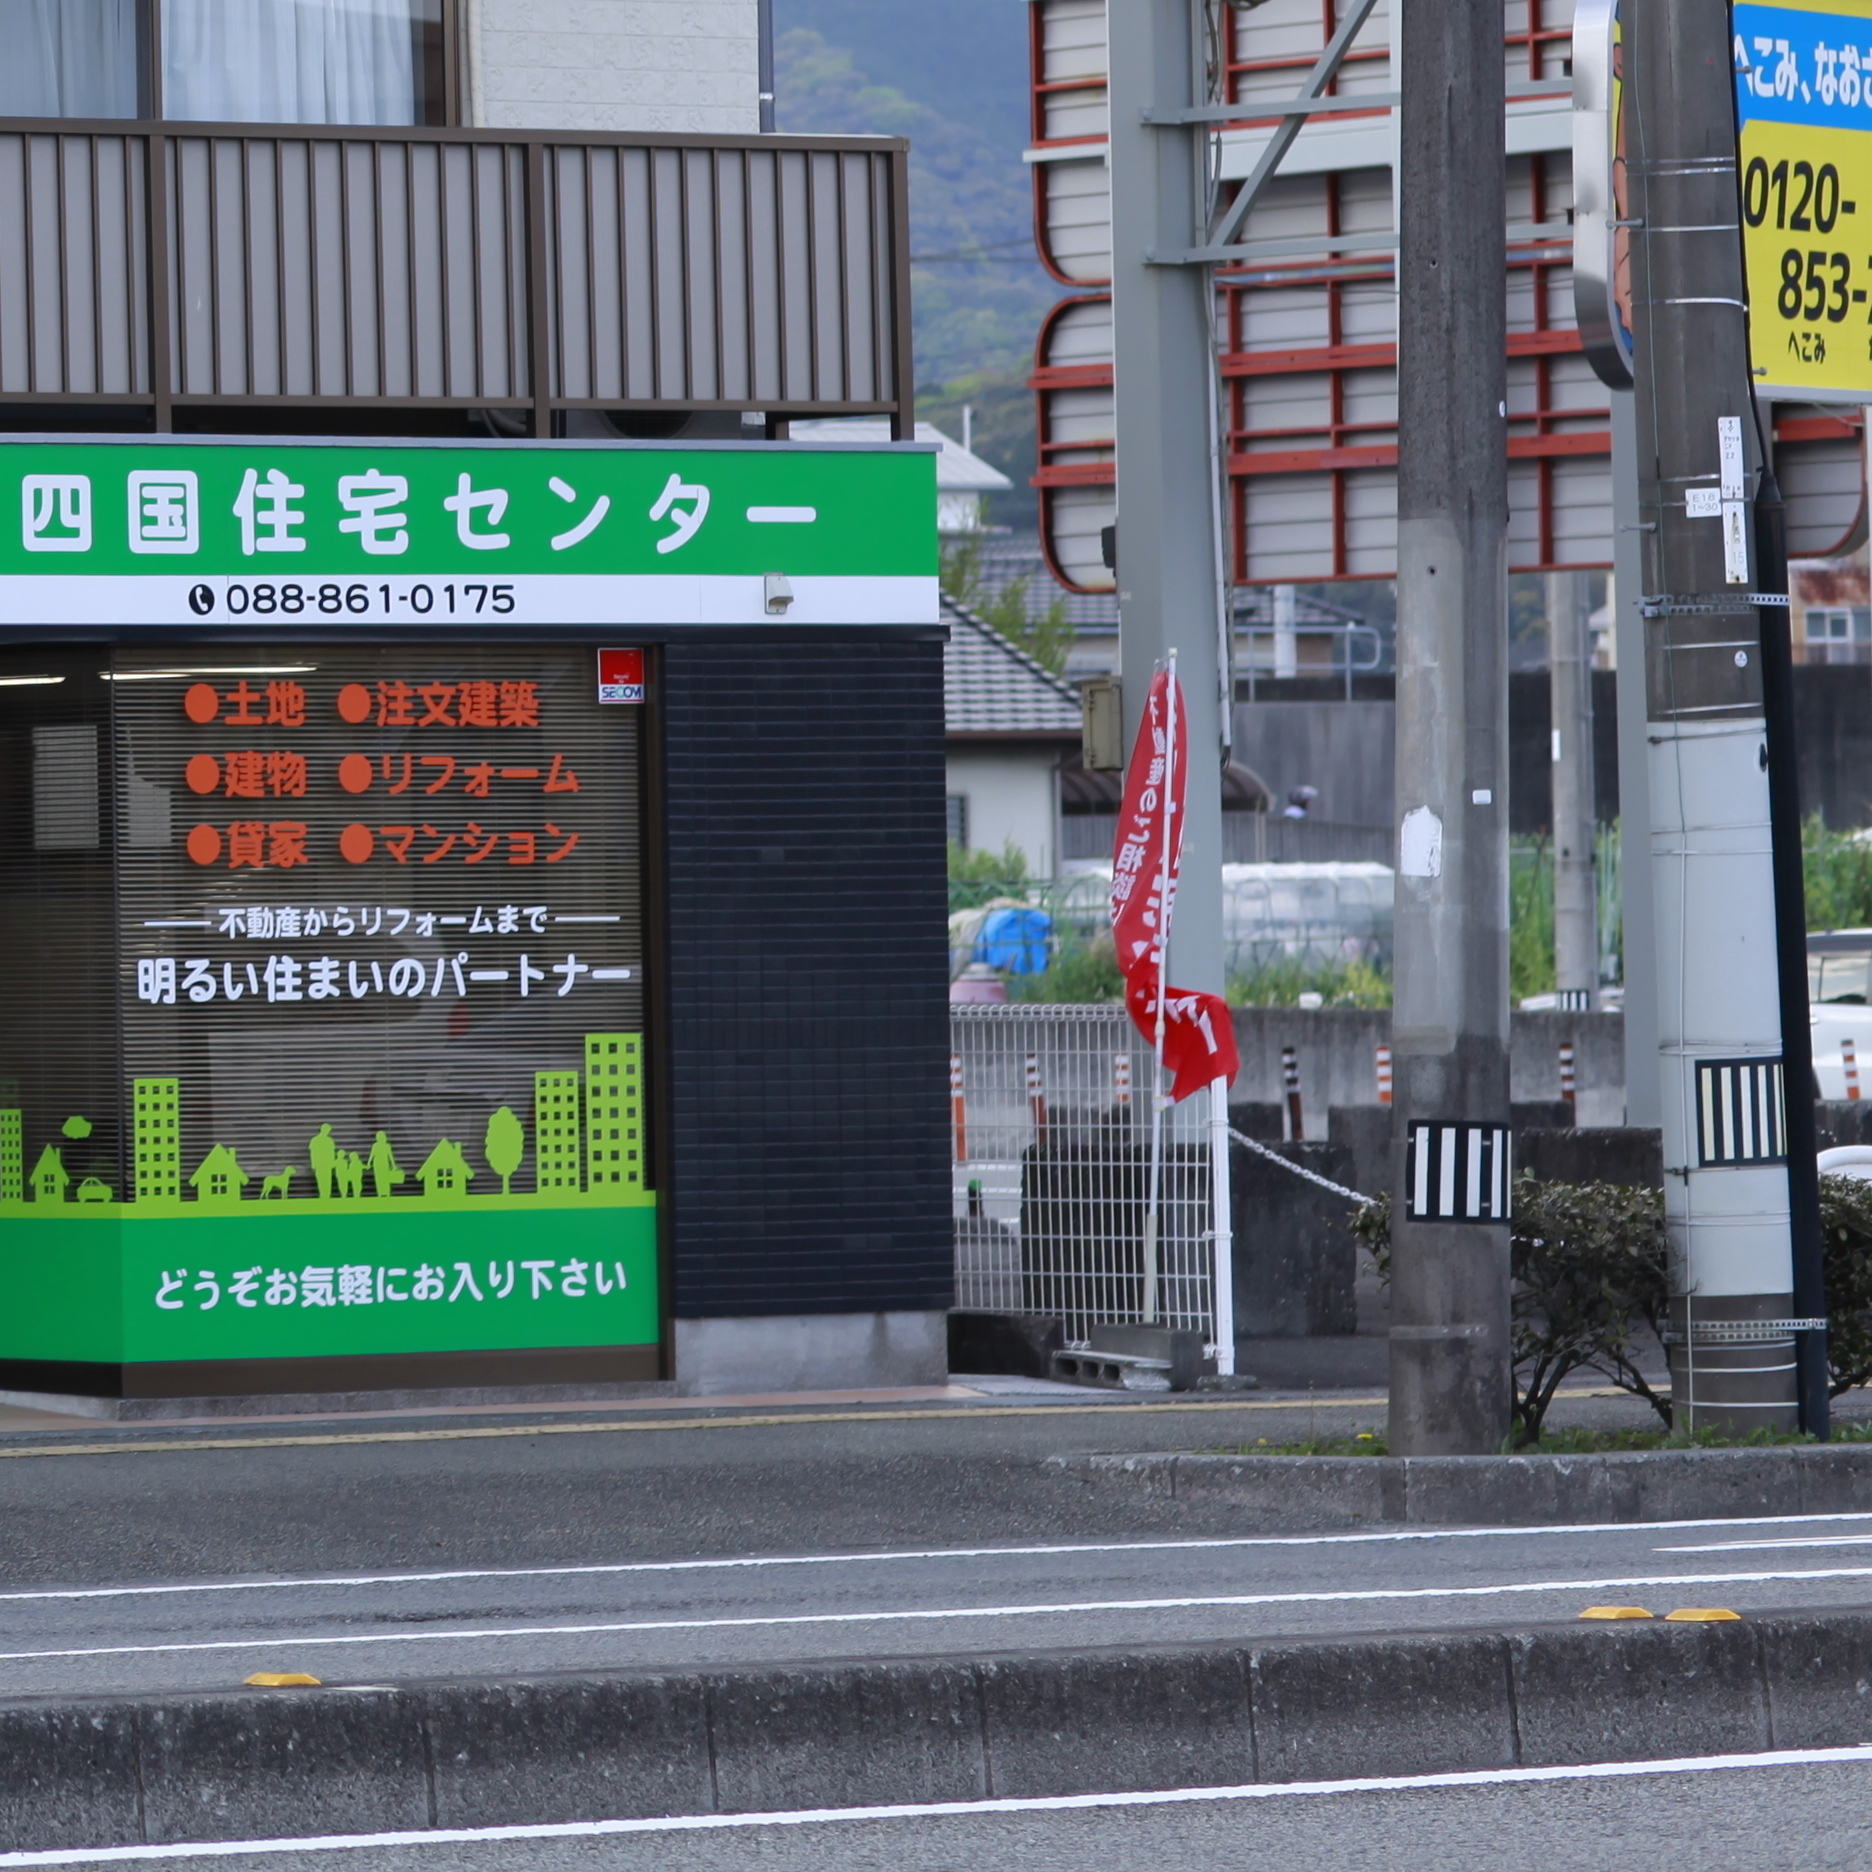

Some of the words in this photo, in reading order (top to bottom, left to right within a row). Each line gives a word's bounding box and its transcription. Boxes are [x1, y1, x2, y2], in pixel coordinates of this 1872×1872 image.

[1778, 248, 1872, 326] 853-
[1788, 331, 1827, 364] へこみ
[225, 583, 516, 615] 088-861-0175
[224, 681, 306, 726] 土地
[376, 681, 540, 728] 注文建築
[601, 686, 642, 698] SECOM
[224, 752, 307, 799] 建物
[381, 753, 581, 798] リフォーム
[227, 820, 309, 870] 貸家
[380, 823, 580, 866] マンション
[218, 905, 548, 940] 不動産からリフォームまで
[136, 951, 631, 1004] 明るい住まいのパートナー
[156, 1257, 627, 1311] どうぞお気軽にお入り下さい
